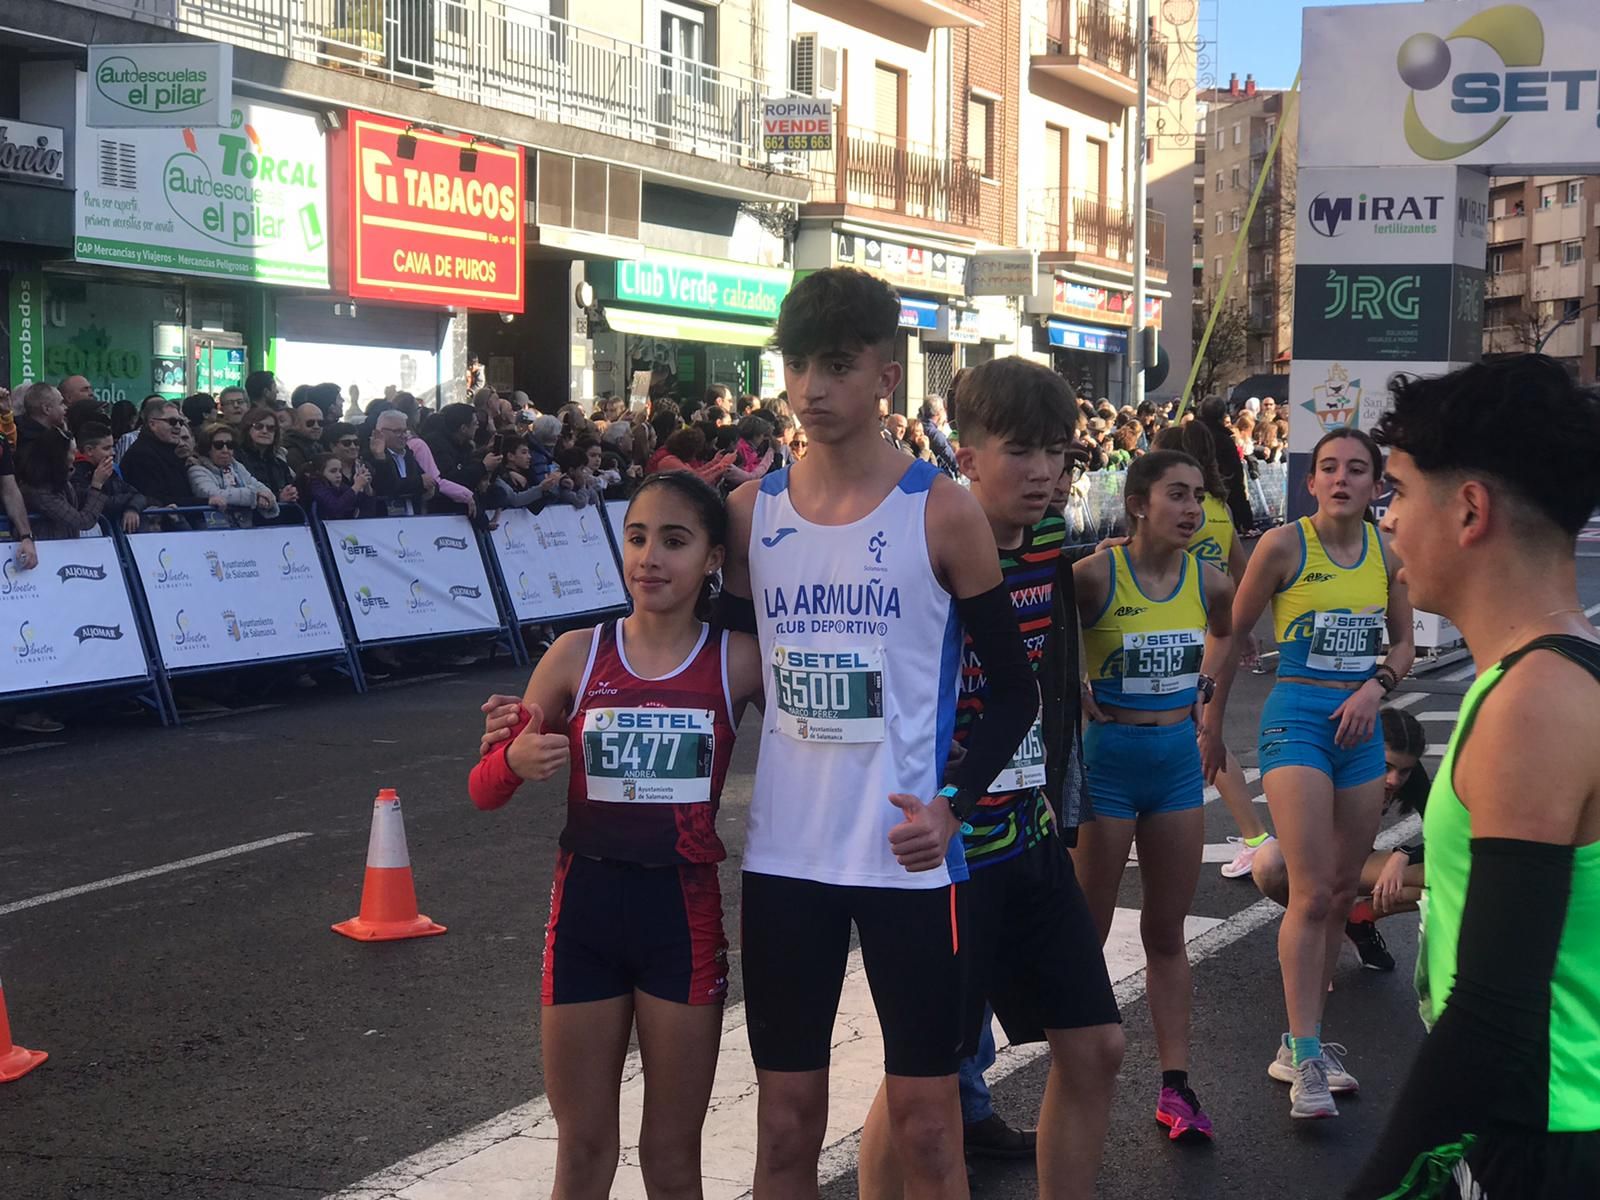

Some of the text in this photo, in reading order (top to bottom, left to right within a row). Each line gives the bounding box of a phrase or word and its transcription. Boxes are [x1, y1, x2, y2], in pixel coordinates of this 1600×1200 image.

[100, 67, 207, 83] autoescuelas
[128, 84, 206, 109] el pilar
[1451, 70, 1600, 114] SET
[765, 103, 831, 116] ROPINAL
[765, 120, 829, 133] VENDE
[765, 135, 831, 149] 662 655 663
[218, 133, 318, 189] TORCAL
[404, 167, 515, 223] TABACOS
[203, 202, 286, 242] el pilar
[1374, 222, 1437, 234] fertilizantes
[77, 242, 93, 254] CAP
[94, 244, 135, 258] Mercancías
[136, 250, 142, 262] y
[142, 250, 171, 263] Viajeros
[393, 249, 496, 283] CAVA DE PUROS
[622, 260, 777, 312] Club Verde calzados
[1324, 274, 1421, 319] JRG
[1363, 396, 1383, 408] San
[1363, 410, 1377, 420] de
[764, 578, 901, 619] LA ARMUÑA
[776, 620, 888, 636] CLUB DEPORTIVO
[1337, 617, 1378, 627] SETEL
[1147, 633, 1197, 646] SETEL
[1323, 628, 1368, 652] 5606
[788, 652, 869, 668] SETEL
[1139, 646, 1184, 673] 5513
[779, 670, 850, 711] 5500
[617, 713, 702, 729] SETEL
[788, 707, 839, 719] MARCO PÉREZ
[809, 726, 843, 735] Ayuntamiento
[816, 732, 843, 740] Salamanca
[602, 733, 682, 770] 5477
[623, 770, 657, 778] ANDREA
[638, 786, 674, 795] Ayuntamiento
[646, 793, 673, 801] Salamanca
